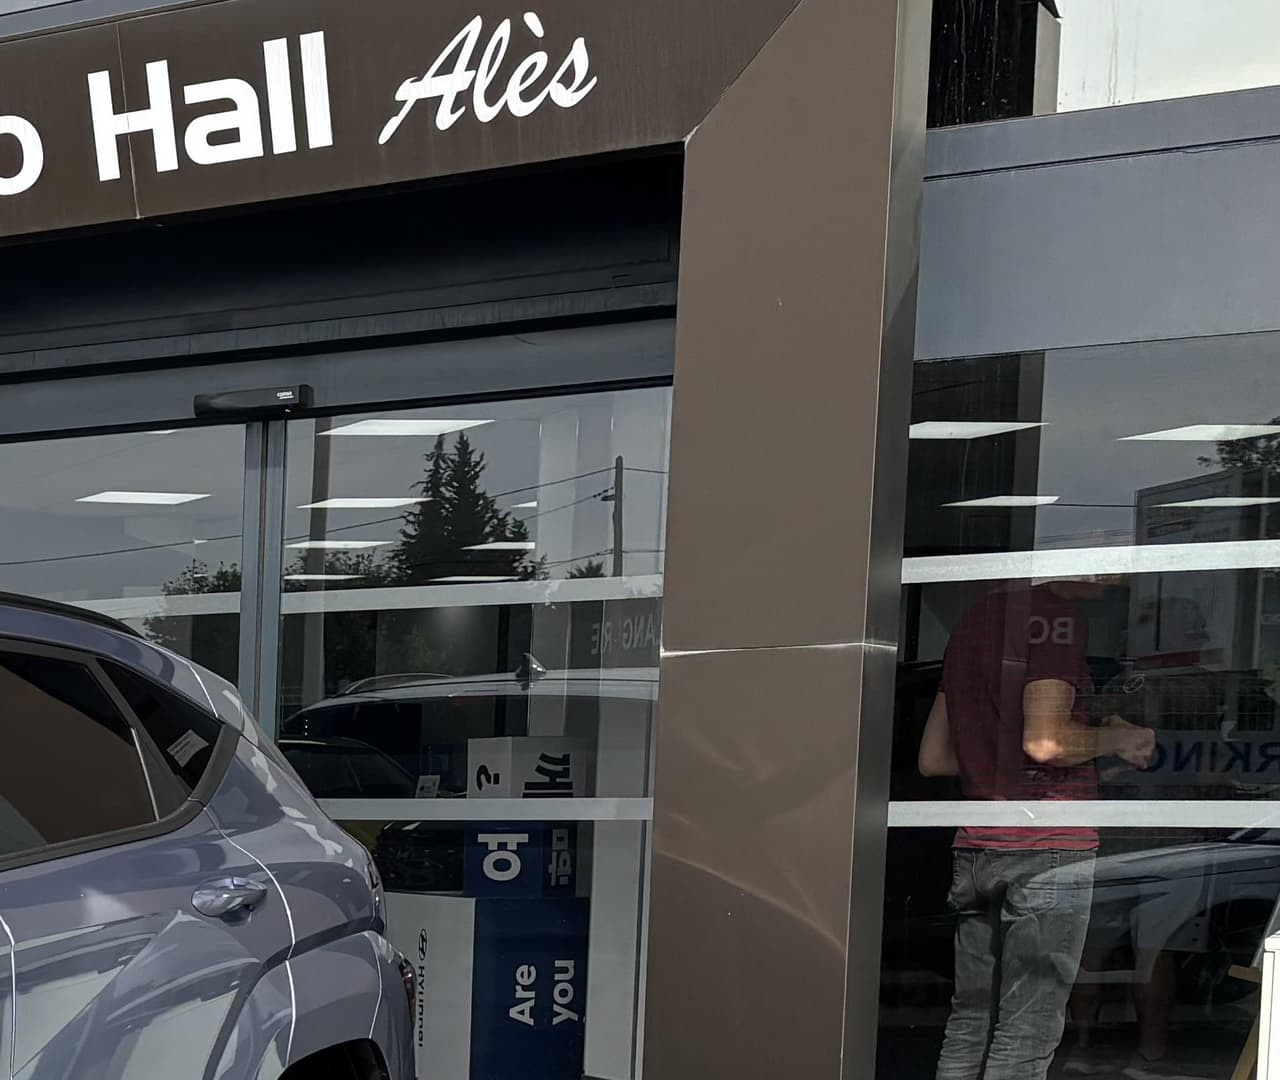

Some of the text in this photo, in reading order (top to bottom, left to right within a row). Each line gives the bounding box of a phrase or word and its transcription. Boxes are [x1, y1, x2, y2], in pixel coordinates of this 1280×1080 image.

[87, 30, 333, 182] Hall
[378, 11, 597, 144] Alès
[509, 964, 536, 1026] Are
[552, 960, 579, 1026] you
